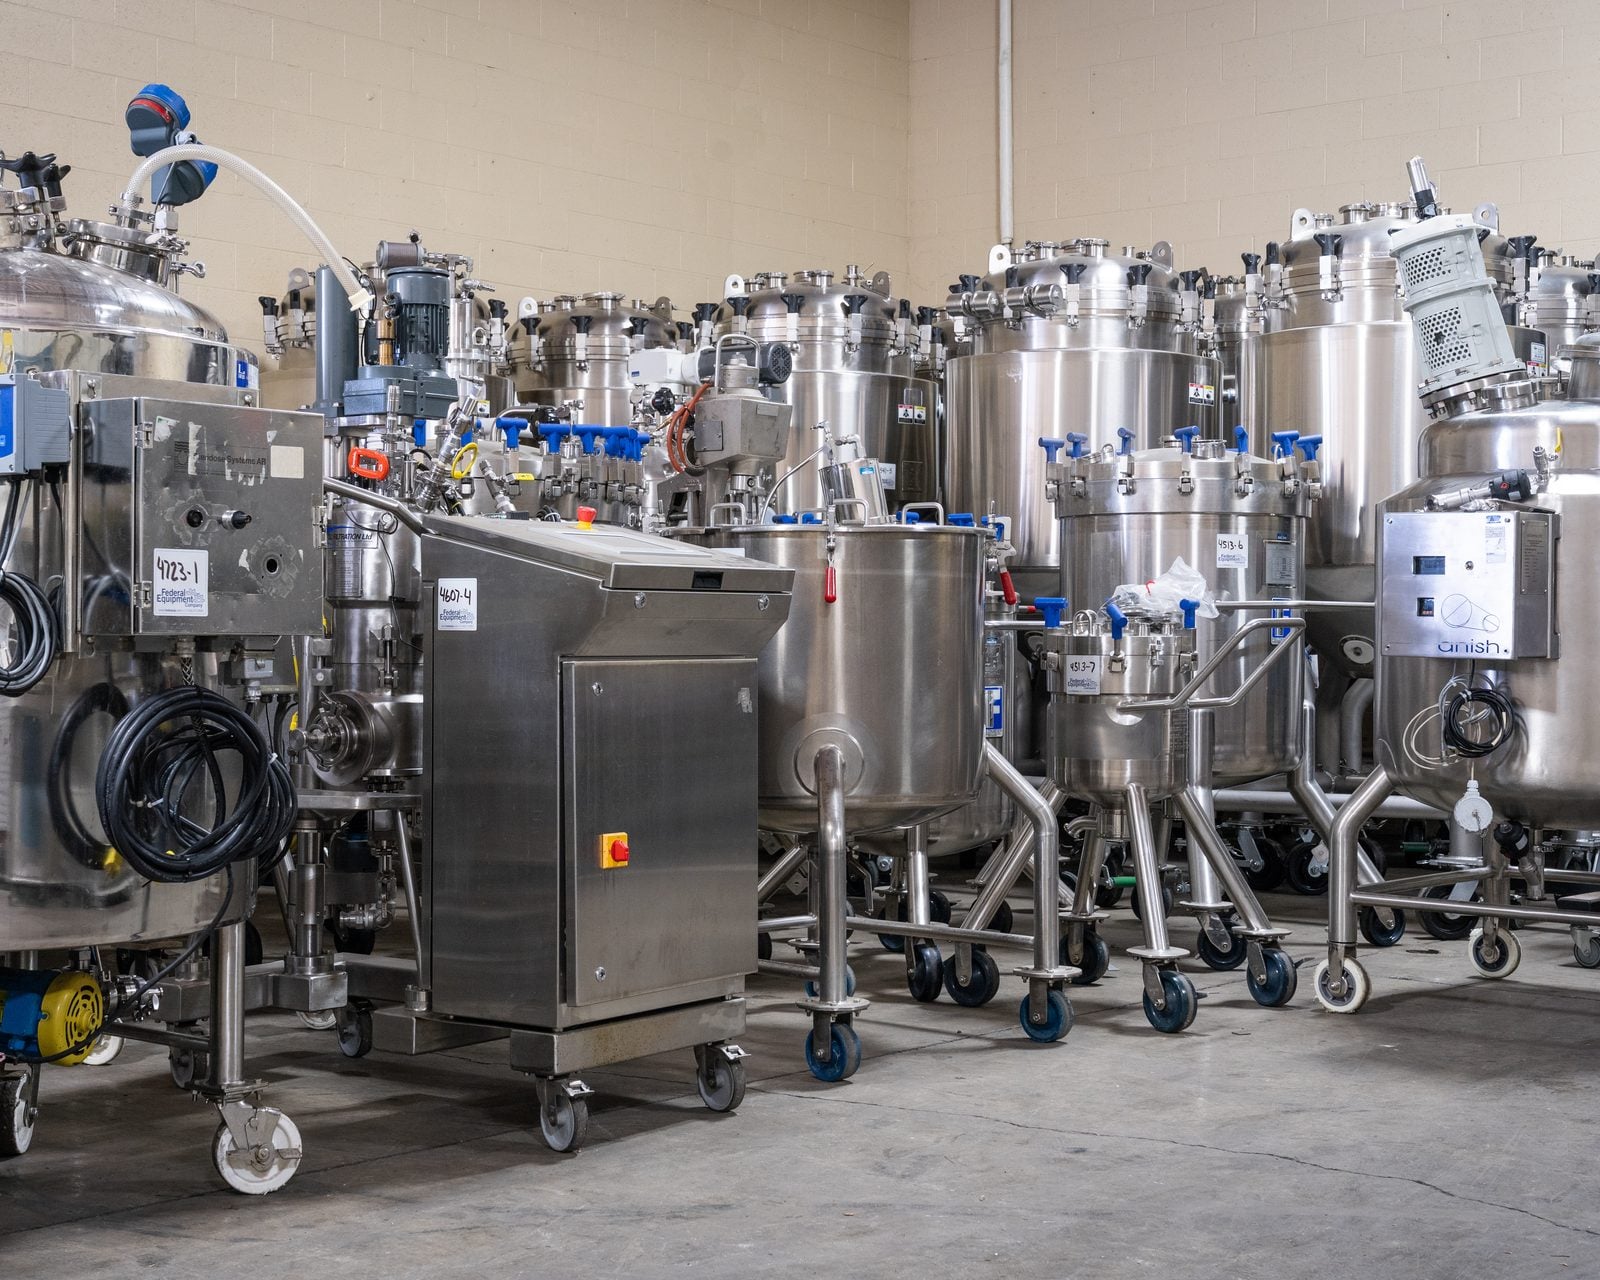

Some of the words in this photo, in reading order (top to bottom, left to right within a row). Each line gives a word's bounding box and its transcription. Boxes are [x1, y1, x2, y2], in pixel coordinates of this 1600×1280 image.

[226, 455, 255, 465] Systems
[157, 556, 198, 584] 4723-1
[161, 588, 186, 597] Federal
[440, 586, 471, 606] 4607-4
[156, 593, 194, 604] Equipment
[439, 613, 467, 621] Equipment
[443, 608, 461, 616] Federal
